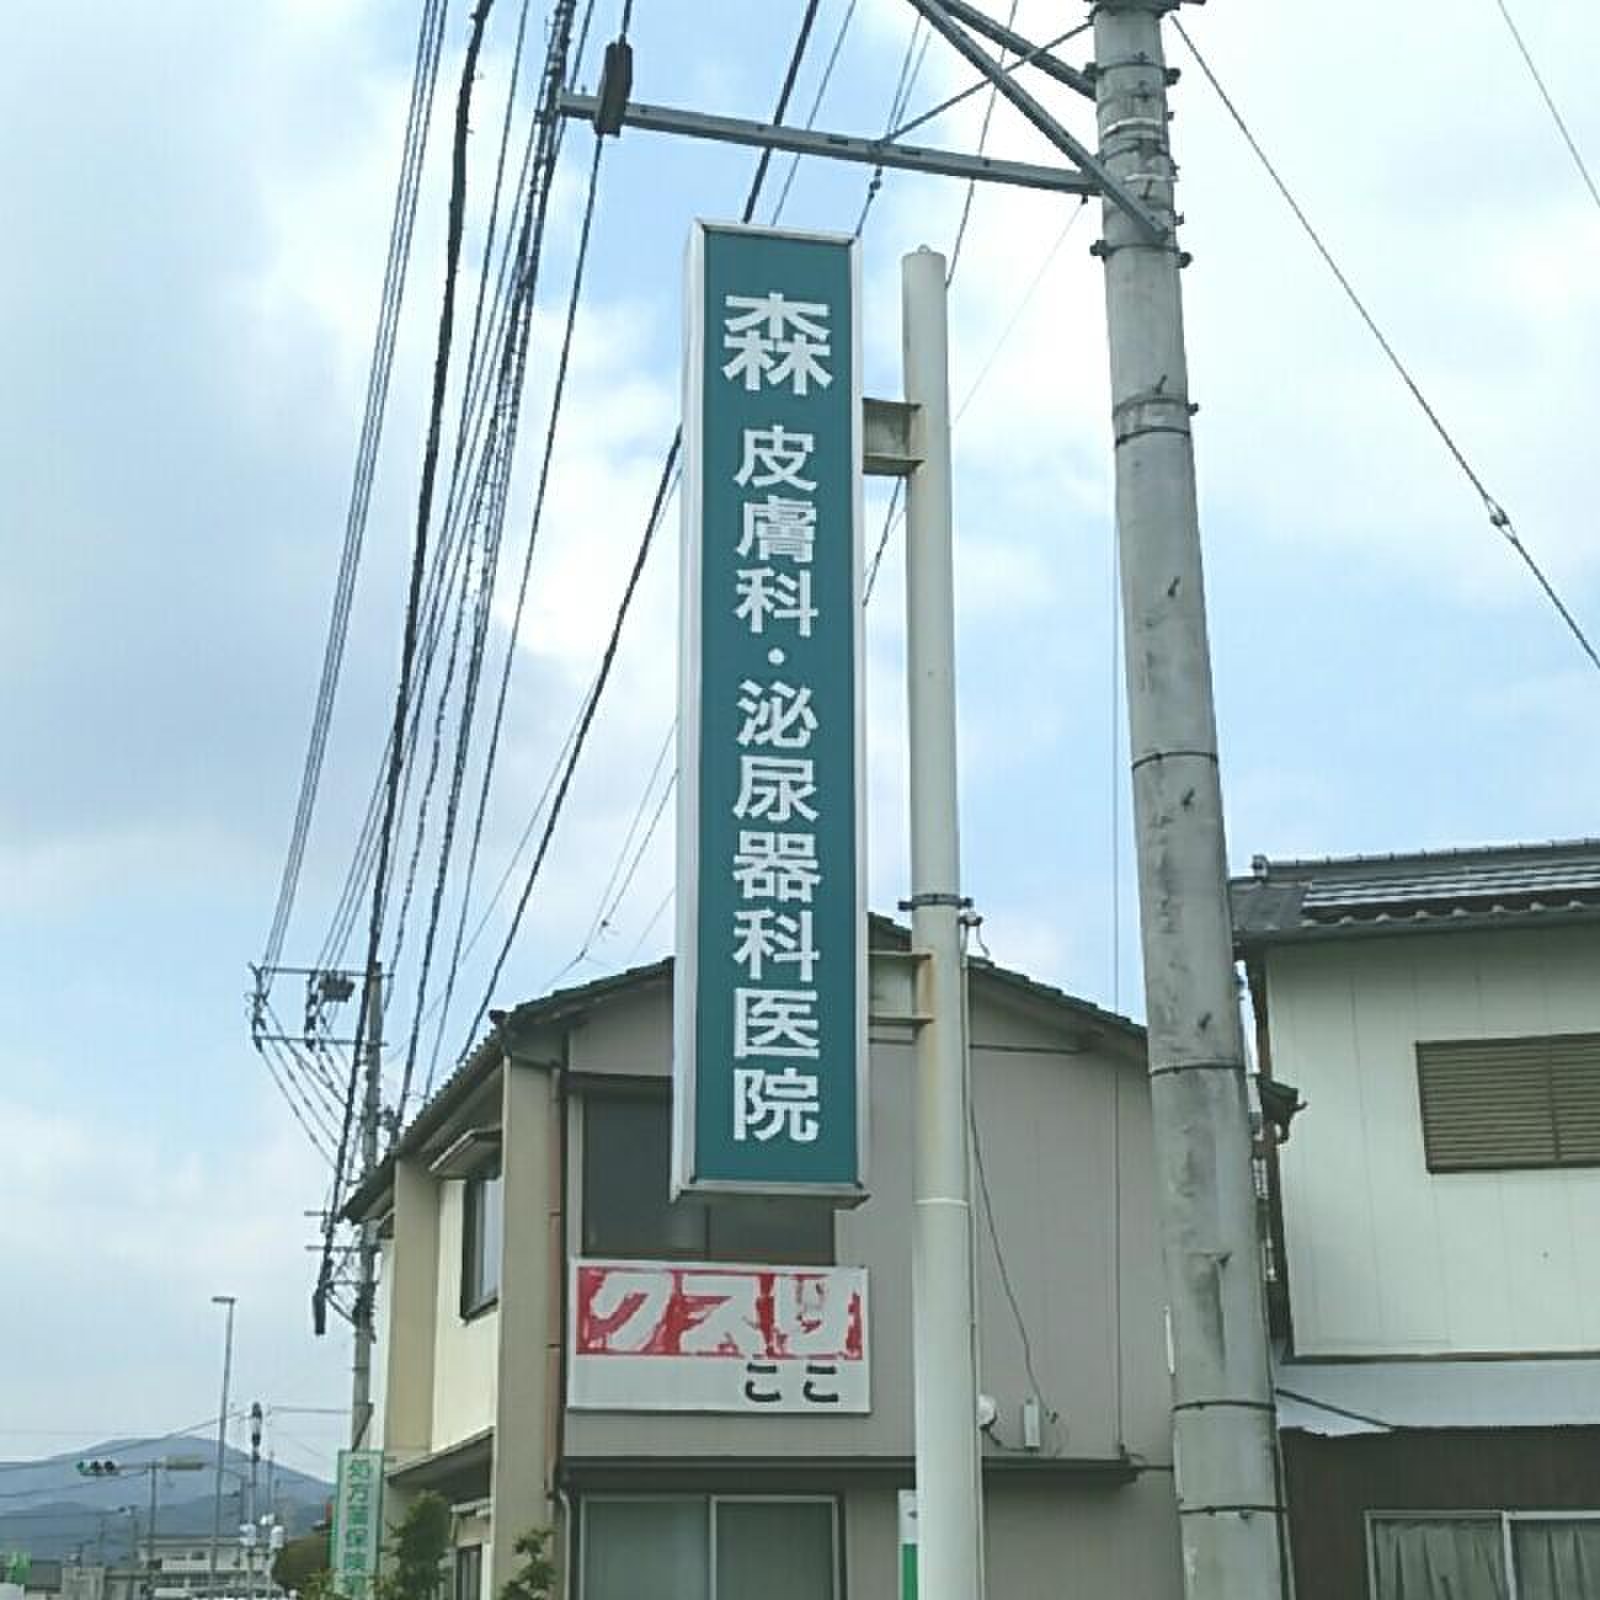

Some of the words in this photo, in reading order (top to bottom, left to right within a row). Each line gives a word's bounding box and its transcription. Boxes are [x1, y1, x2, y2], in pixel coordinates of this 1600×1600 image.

[723, 292, 833, 396] 森
[733, 425, 821, 1141] 皮膚科・泌尿器科医院
[589, 1270, 857, 1358] クスリ
[745, 1361, 839, 1402] ここ
